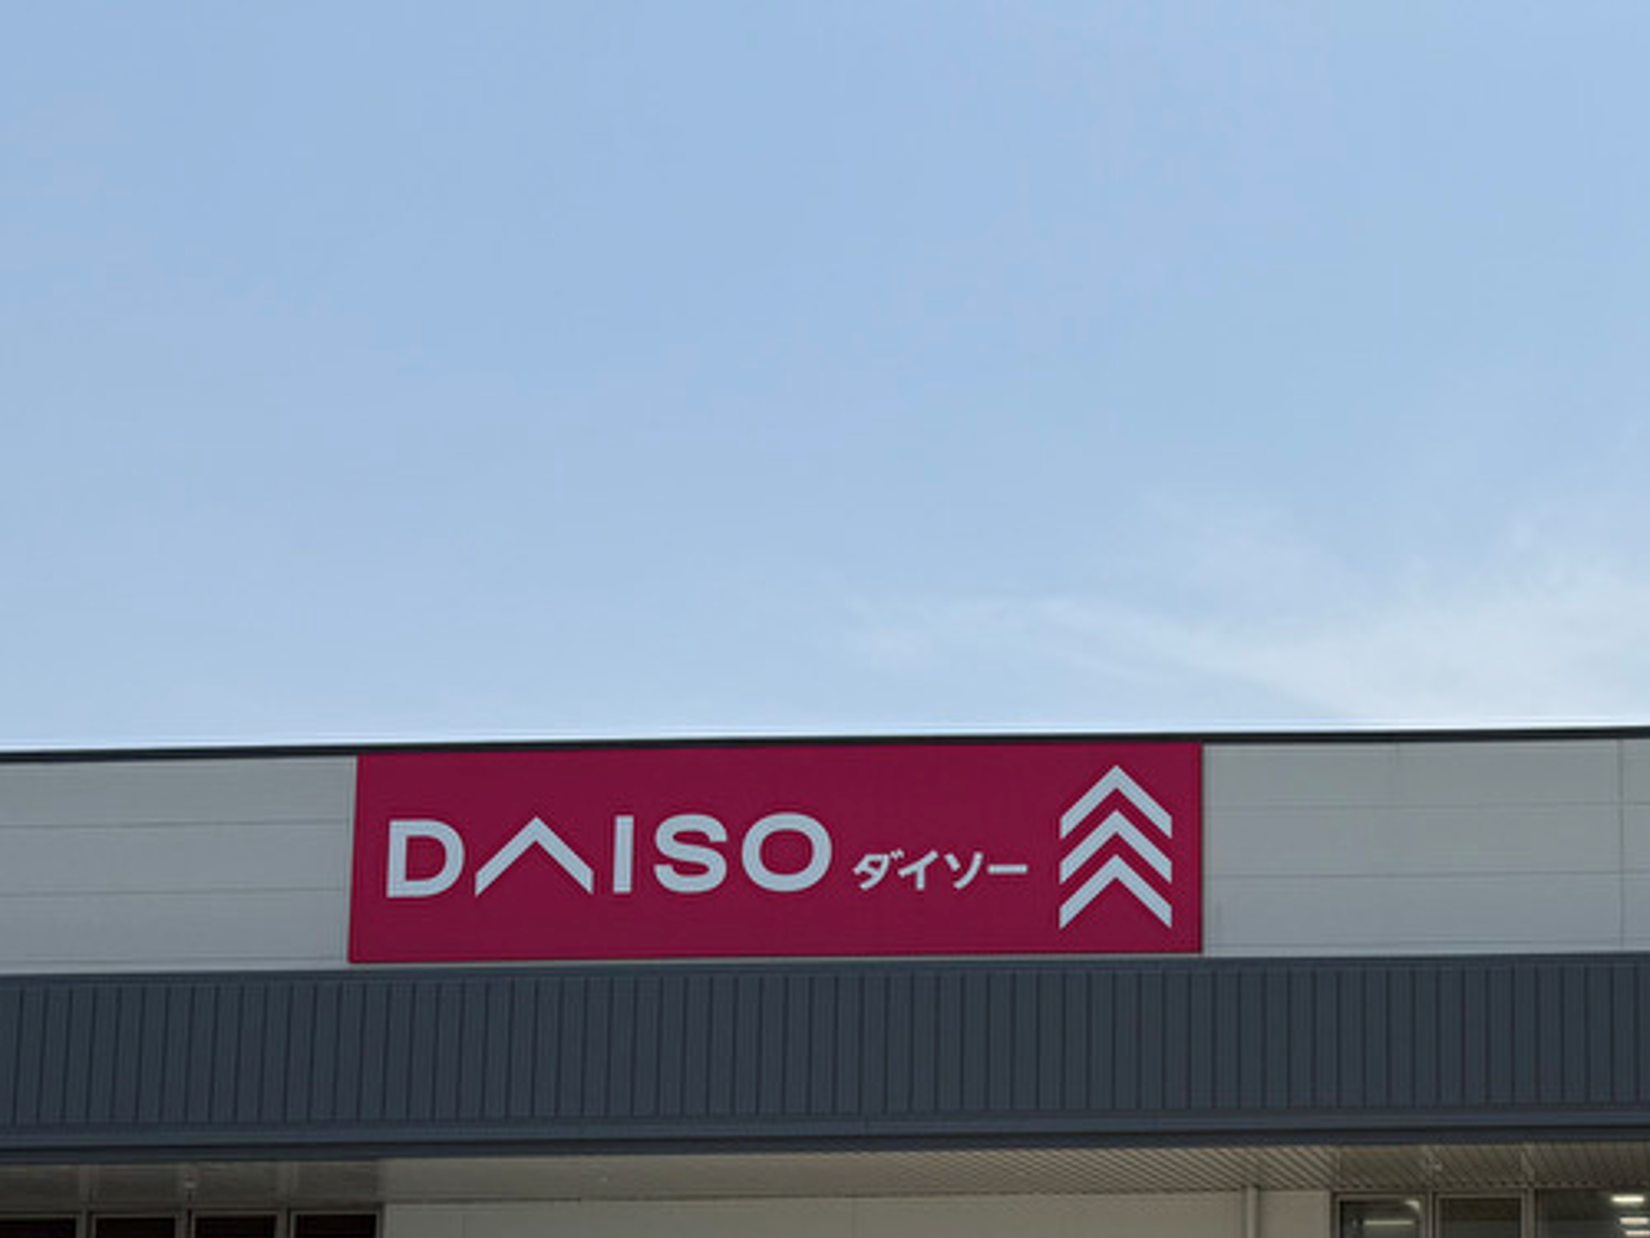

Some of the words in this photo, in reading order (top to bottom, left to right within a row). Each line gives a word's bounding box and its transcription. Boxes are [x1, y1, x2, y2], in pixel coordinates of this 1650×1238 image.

[386, 813, 833, 898] DAISO
[853, 850, 1028, 891] ダイソー
